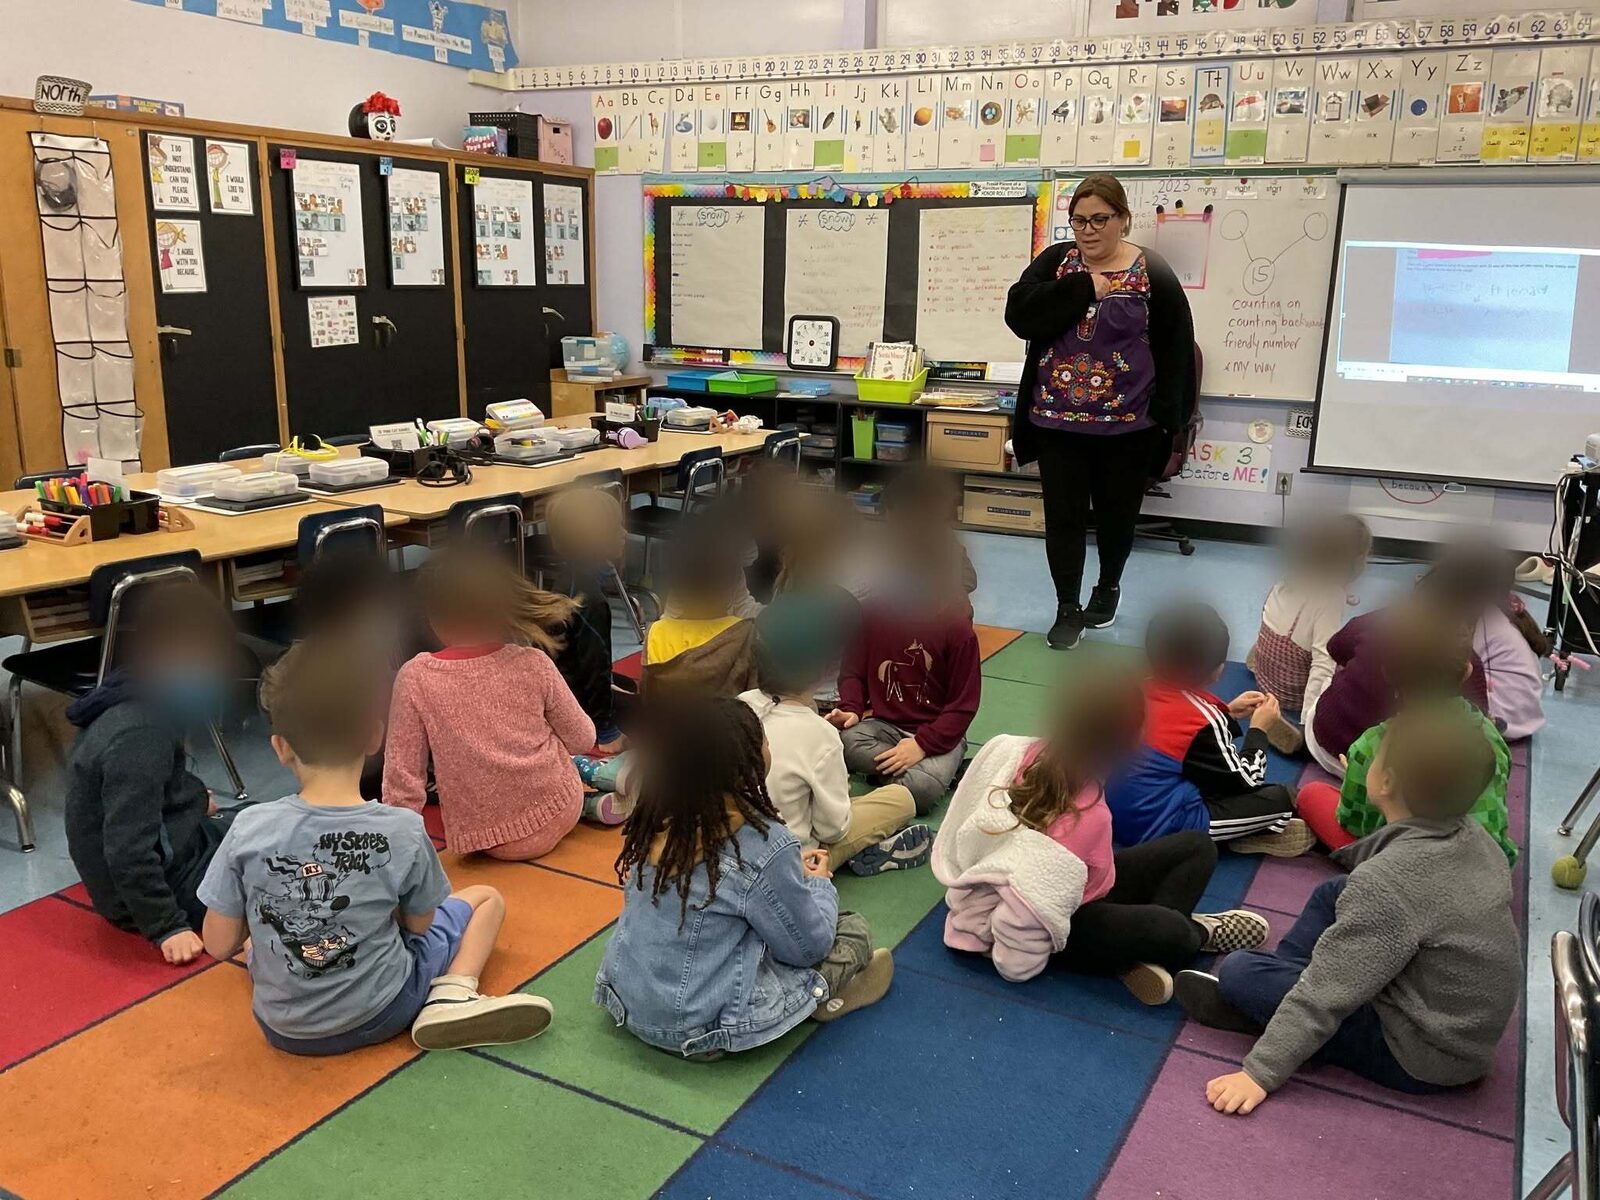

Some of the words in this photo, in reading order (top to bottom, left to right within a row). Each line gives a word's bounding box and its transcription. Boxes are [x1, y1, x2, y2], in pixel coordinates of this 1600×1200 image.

[532, 74, 536, 82] 2
[544, 73, 549, 81] 3
[556, 72, 561, 80] 4
[568, 72, 574, 80] 5
[580, 71, 586, 80] 6
[594, 70, 598, 79] 7
[606, 70, 611, 78] 8
[618, 69, 624, 78] 9
[630, 68, 638, 78] 10
[644, 68, 651, 77] 11
[658, 67, 665, 76] 12
[670, 66, 678, 76] 13
[684, 66, 692, 75] 14
[697, 65, 705, 75] 15
[711, 65, 718, 74] 16
[724, 64, 732, 73] 17
[739, 63, 746, 72] 18
[752, 62, 760, 72] 19
[765, 62, 775, 71] 20
[780, 61, 788, 70] 21
[794, 60, 804, 70] 22
[809, 59, 818, 69] 23
[823, 58, 833, 68] 24
[839, 58, 848, 68] 25
[854, 57, 863, 67] 26
[869, 56, 878, 66] 27
[885, 55, 894, 65] 28
[900, 54, 910, 65] 29
[916, 53, 926, 63] 30
[932, 53, 940, 62] 31
[949, 52, 959, 62] 32
[964, 51, 974, 61] 33
[981, 50, 992, 60] 34
[998, 49, 1008, 60] 35
[1015, 48, 1025, 58] 36
[1032, 47, 1042, 58] 37
[1050, 46, 1060, 57] 38
[1067, 45, 1078, 56] 39
[1084, 44, 1096, 54] 40
[1103, 43, 1112, 53] 41
[1121, 42, 1132, 53] 42
[1139, 42, 1150, 52] 43
[1157, 40, 1168, 51] 44
[1176, 39, 1188, 50] 45
[1195, 38, 1206, 49] 46
[1214, 37, 1226, 48] 47
[1234, 36, 1246, 47] 48
[1254, 35, 1266, 46] 49
[1273, 34, 1285, 45] 50
[1293, 33, 1304, 44] 51
[1313, 32, 1326, 43] 52
[1334, 31, 1346, 42] 53
[1397, 27, 1410, 39] 56
[1418, 26, 1432, 38] 57
[1440, 25, 1454, 37] 58
[1462, 24, 1476, 36] 59
[1485, 23, 1500, 35] 60
[1507, 22, 1520, 33] 61
[1531, 20, 1546, 32] 62
[1554, 19, 1568, 31] 63
[1577, 18, 1592, 30] 64
[1252, 265, 1270, 284] 15
[1232, 295, 1281, 317] counting
[1287, 300, 1301, 308] on
[1229, 314, 1277, 334] counting
[1224, 331, 1259, 357] friendly
[1263, 335, 1301, 350] number
[1237, 447, 1253, 464] 3
[1180, 462, 1230, 480] Before
